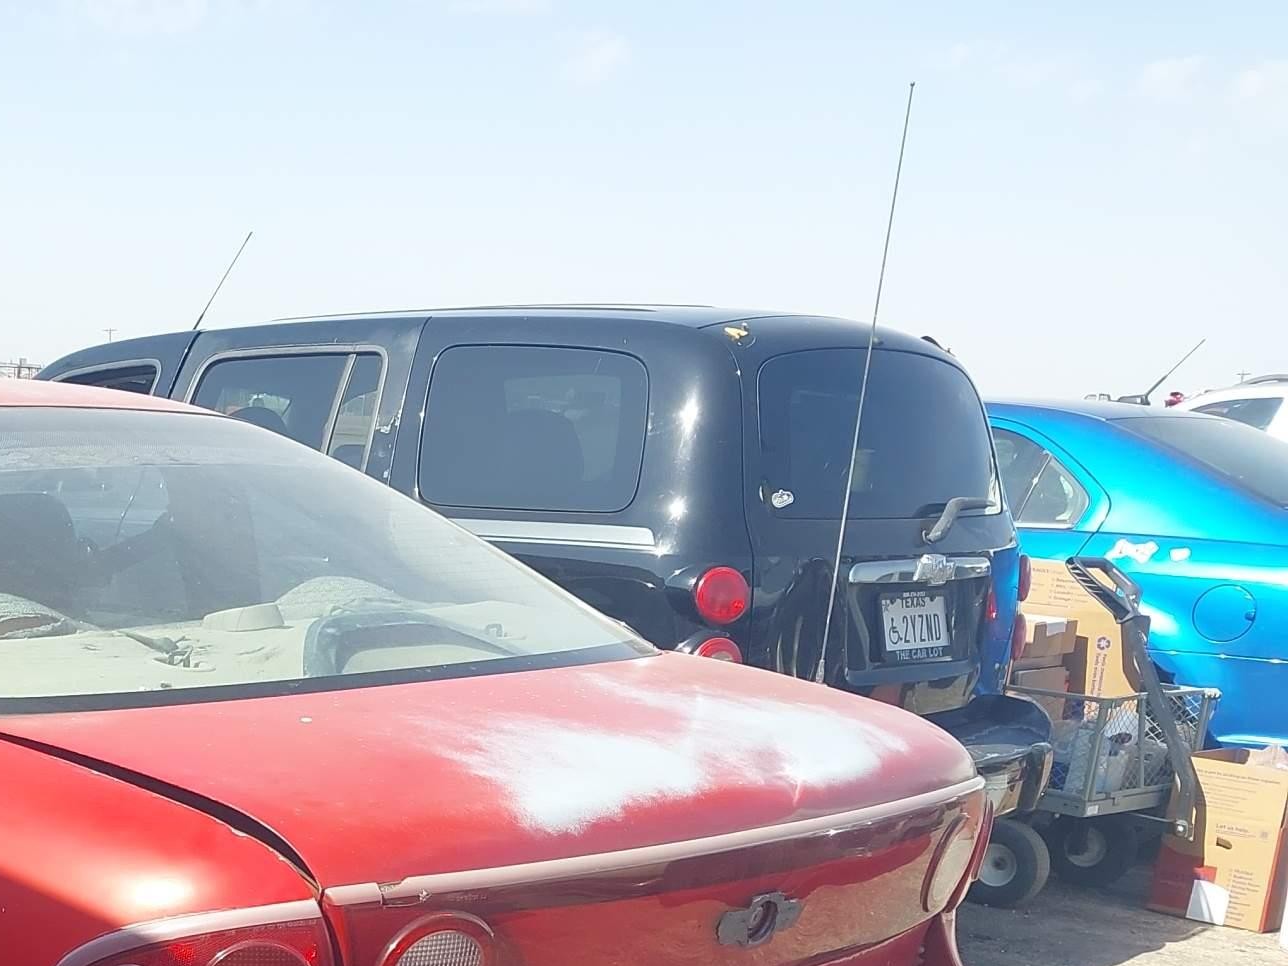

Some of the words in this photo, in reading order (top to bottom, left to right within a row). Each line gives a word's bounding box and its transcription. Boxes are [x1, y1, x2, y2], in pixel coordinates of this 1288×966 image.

[901, 598, 926, 609] TEXAS
[896, 650, 911, 660] THE
[912, 649, 927, 659] CAR
[928, 647, 943, 657] LOT
